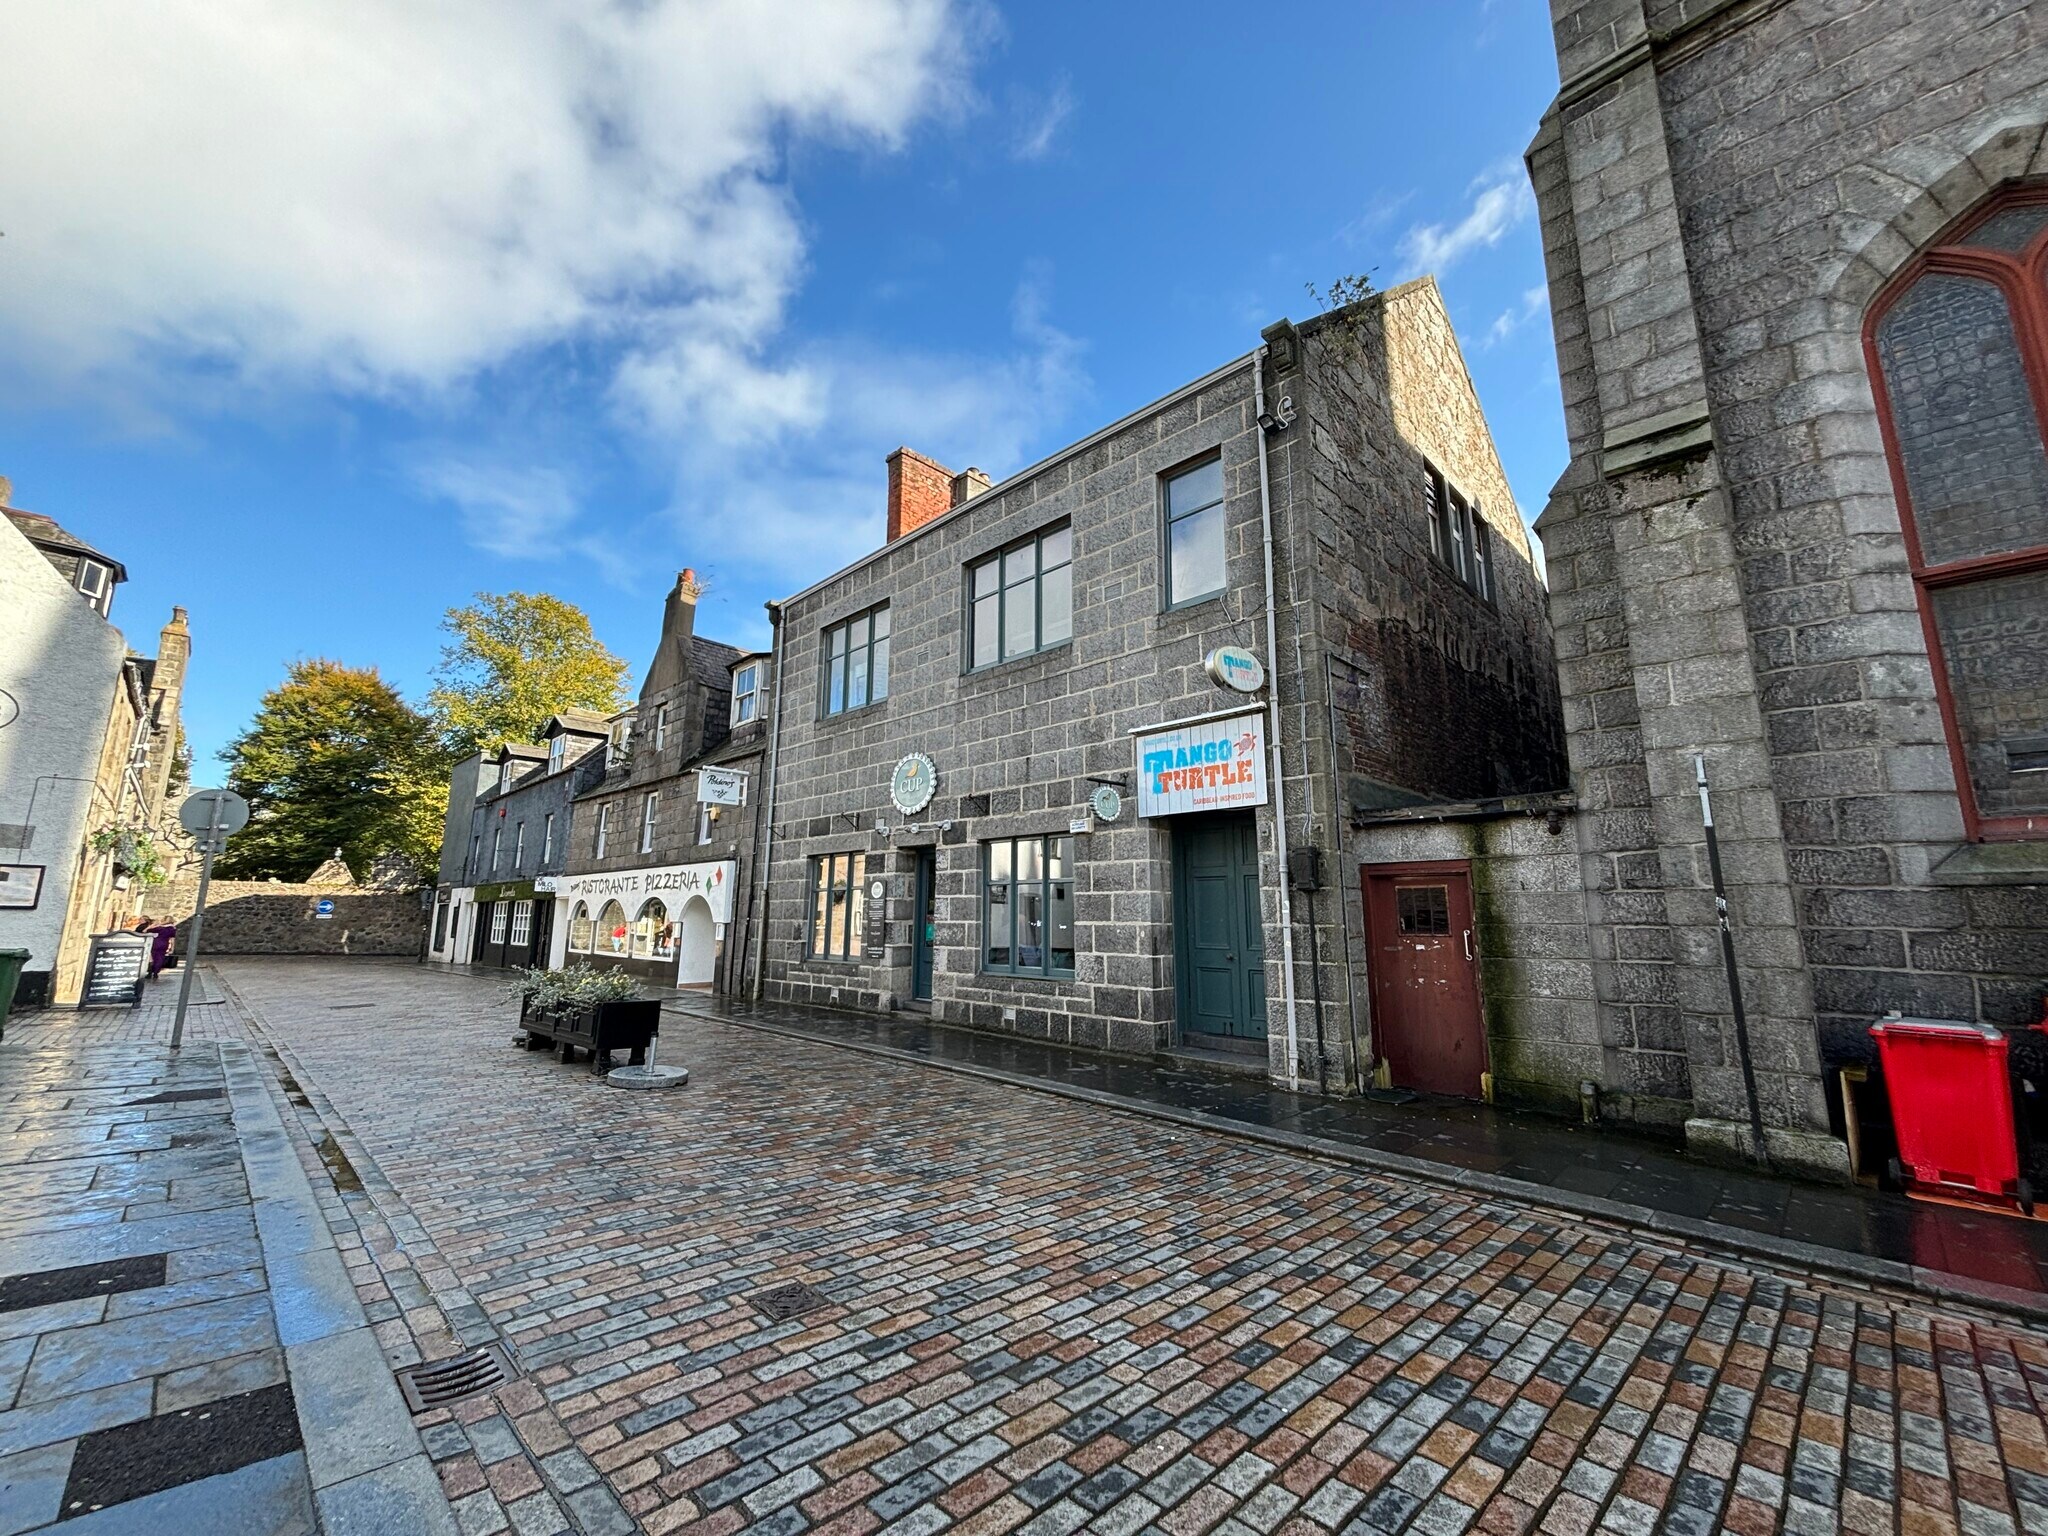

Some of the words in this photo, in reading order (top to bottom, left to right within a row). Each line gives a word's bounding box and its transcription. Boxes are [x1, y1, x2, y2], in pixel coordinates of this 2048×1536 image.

[1143, 738, 1233, 795] TANGO
[1158, 759, 1253, 794] TURTLE
[900, 777, 922, 793] CUP
[1219, 793, 1241, 803] INSPIRED
[1242, 792, 1255, 800] FOOD
[581, 876, 639, 896] RISTORANTE
[645, 870, 700, 894] PIZZERIA
